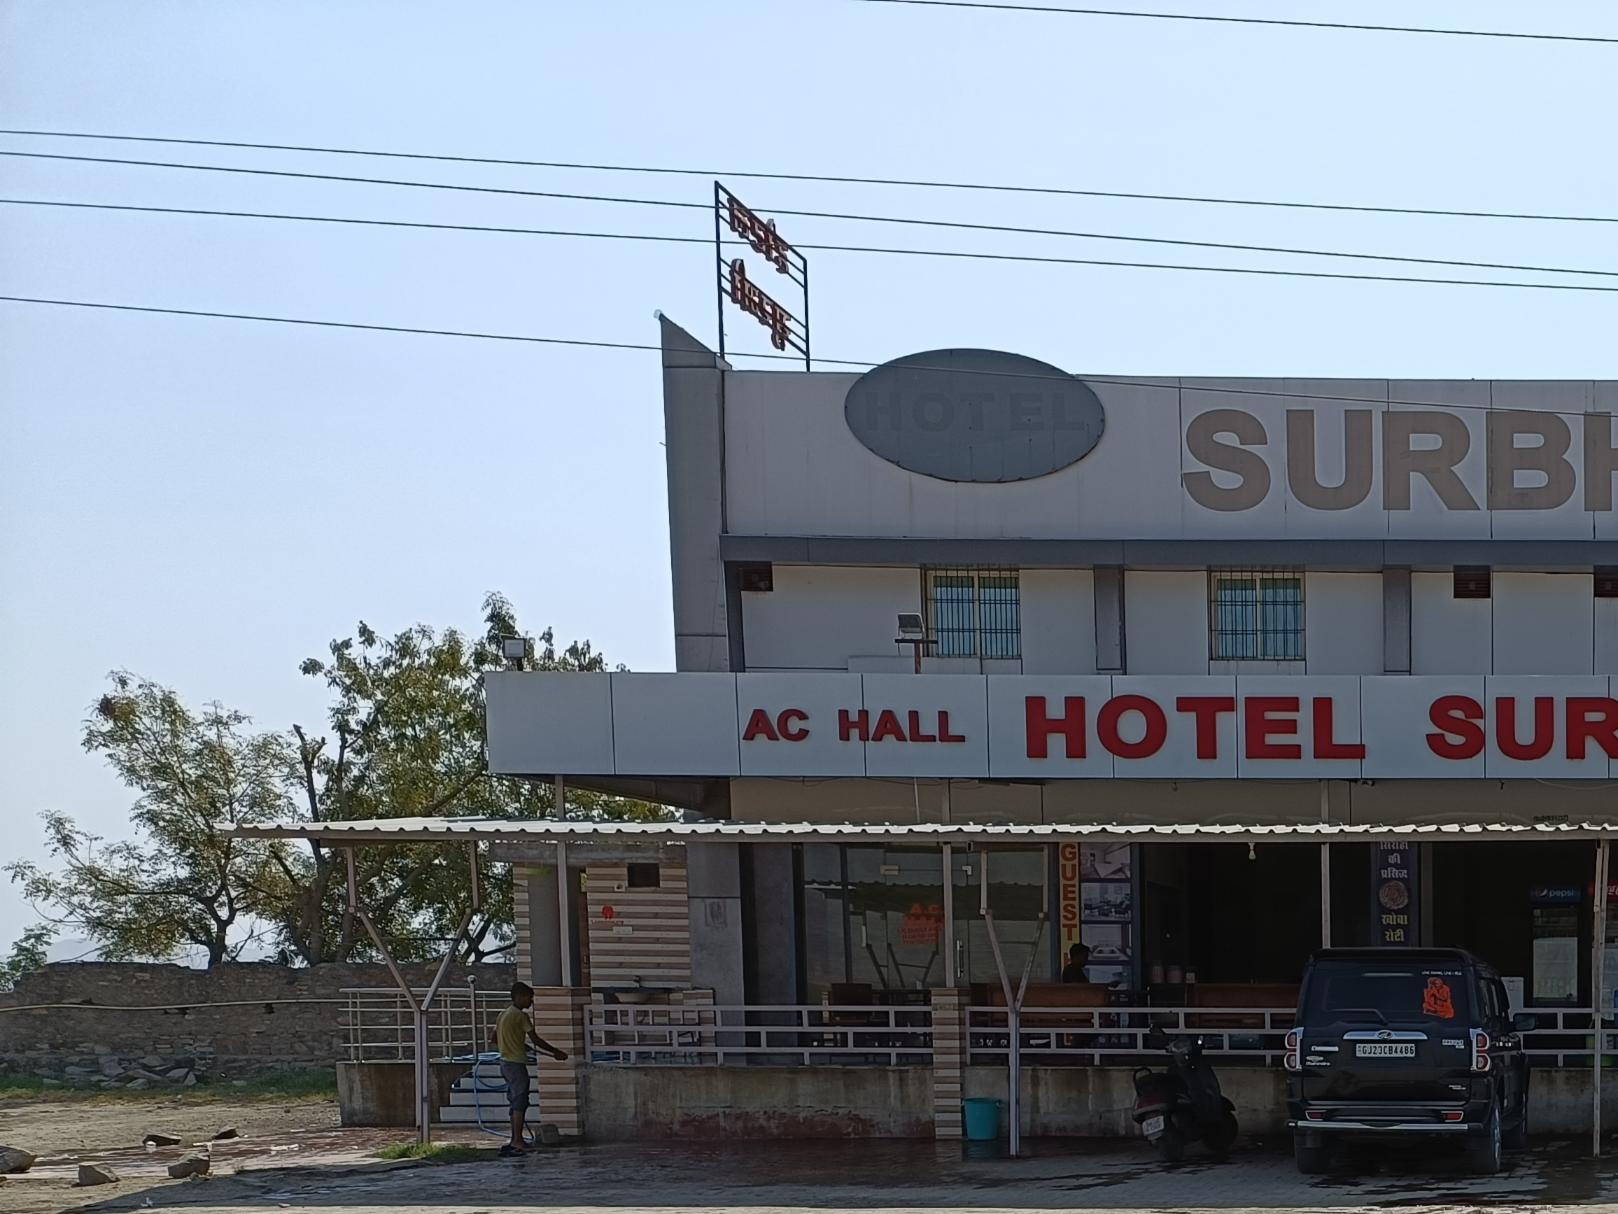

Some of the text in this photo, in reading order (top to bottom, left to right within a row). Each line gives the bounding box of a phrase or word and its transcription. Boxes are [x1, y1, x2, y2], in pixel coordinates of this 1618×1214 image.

[865, 391, 1085, 432] HOTEL
[742, 708, 966, 743] AC HALL
[1025, 694, 1366, 760] HOTEL
[1061, 844, 1079, 941] GUEST
